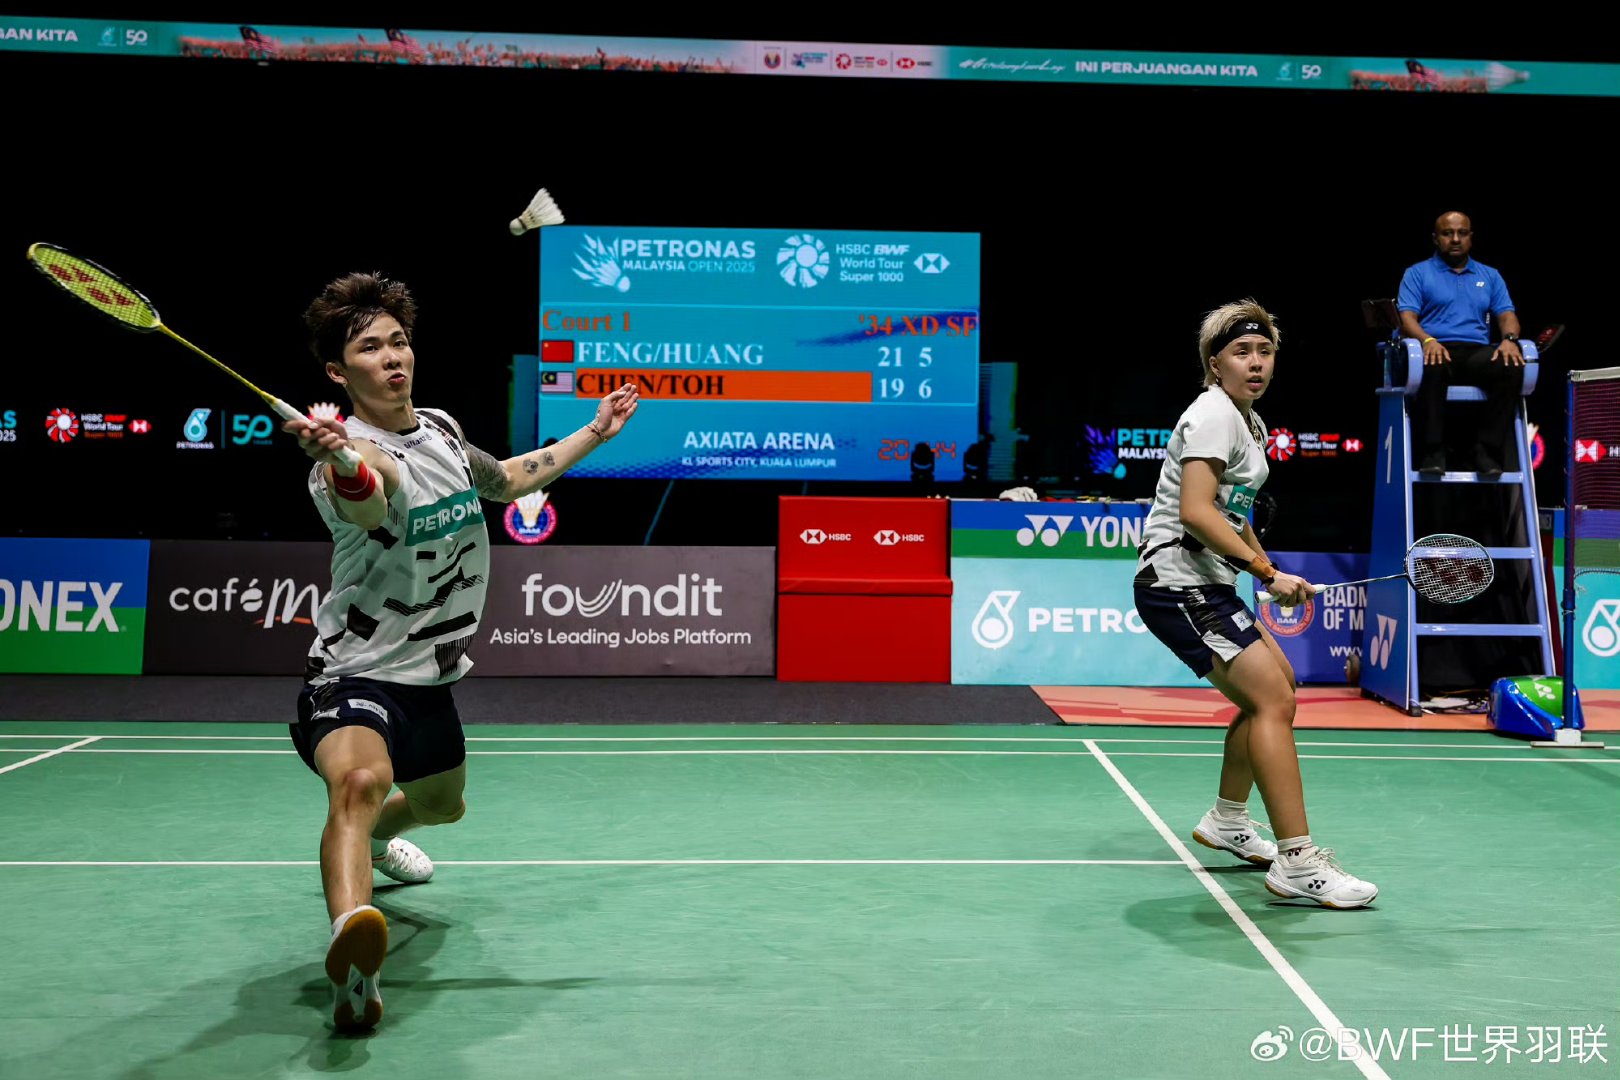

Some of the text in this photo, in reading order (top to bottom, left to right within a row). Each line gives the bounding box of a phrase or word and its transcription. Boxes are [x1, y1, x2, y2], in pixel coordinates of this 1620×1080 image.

[36, 29, 78, 42] KITA
[126, 29, 148, 46] 50
[1075, 61, 1098, 73] INI
[1101, 61, 1217, 76] PERJUANGAN
[1220, 65, 1258, 77] KITA
[1302, 65, 1321, 79] 50
[621, 239, 756, 259] PETRONAS
[836, 244, 910, 256] HSBC BWF
[622, 260, 755, 273] MALAYSIA OPEN 2025
[840, 257, 904, 270] World Tour
[840, 271, 904, 284] Super 1000
[542, 309, 631, 332] Court 1
[901, 316, 939, 336] XD
[946, 315, 977, 337] SF
[577, 341, 764, 366] FENG/HUANG
[878, 346, 932, 367] 21 5
[880, 378, 932, 399] 19 6
[0, 410, 17, 429] S
[84, 422, 106, 431] World
[233, 414, 273, 445] 50
[684, 432, 835, 450] AXIATA ARENA
[681, 456, 837, 468] KL SPORTS CITY, KUALA LUMPUR
[1384, 425, 1393, 484] 1
[828, 532, 852, 541] HSBC
[902, 533, 925, 542] HSBC
[1081, 515, 1148, 548] YON
[521, 573, 722, 618] foundit
[1028, 608, 1149, 634] PETRO
[1323, 608, 1345, 631] OF
[547, 629, 620, 648] Leading
[624, 629, 669, 644] Jobs
[674, 629, 752, 645] Platform
